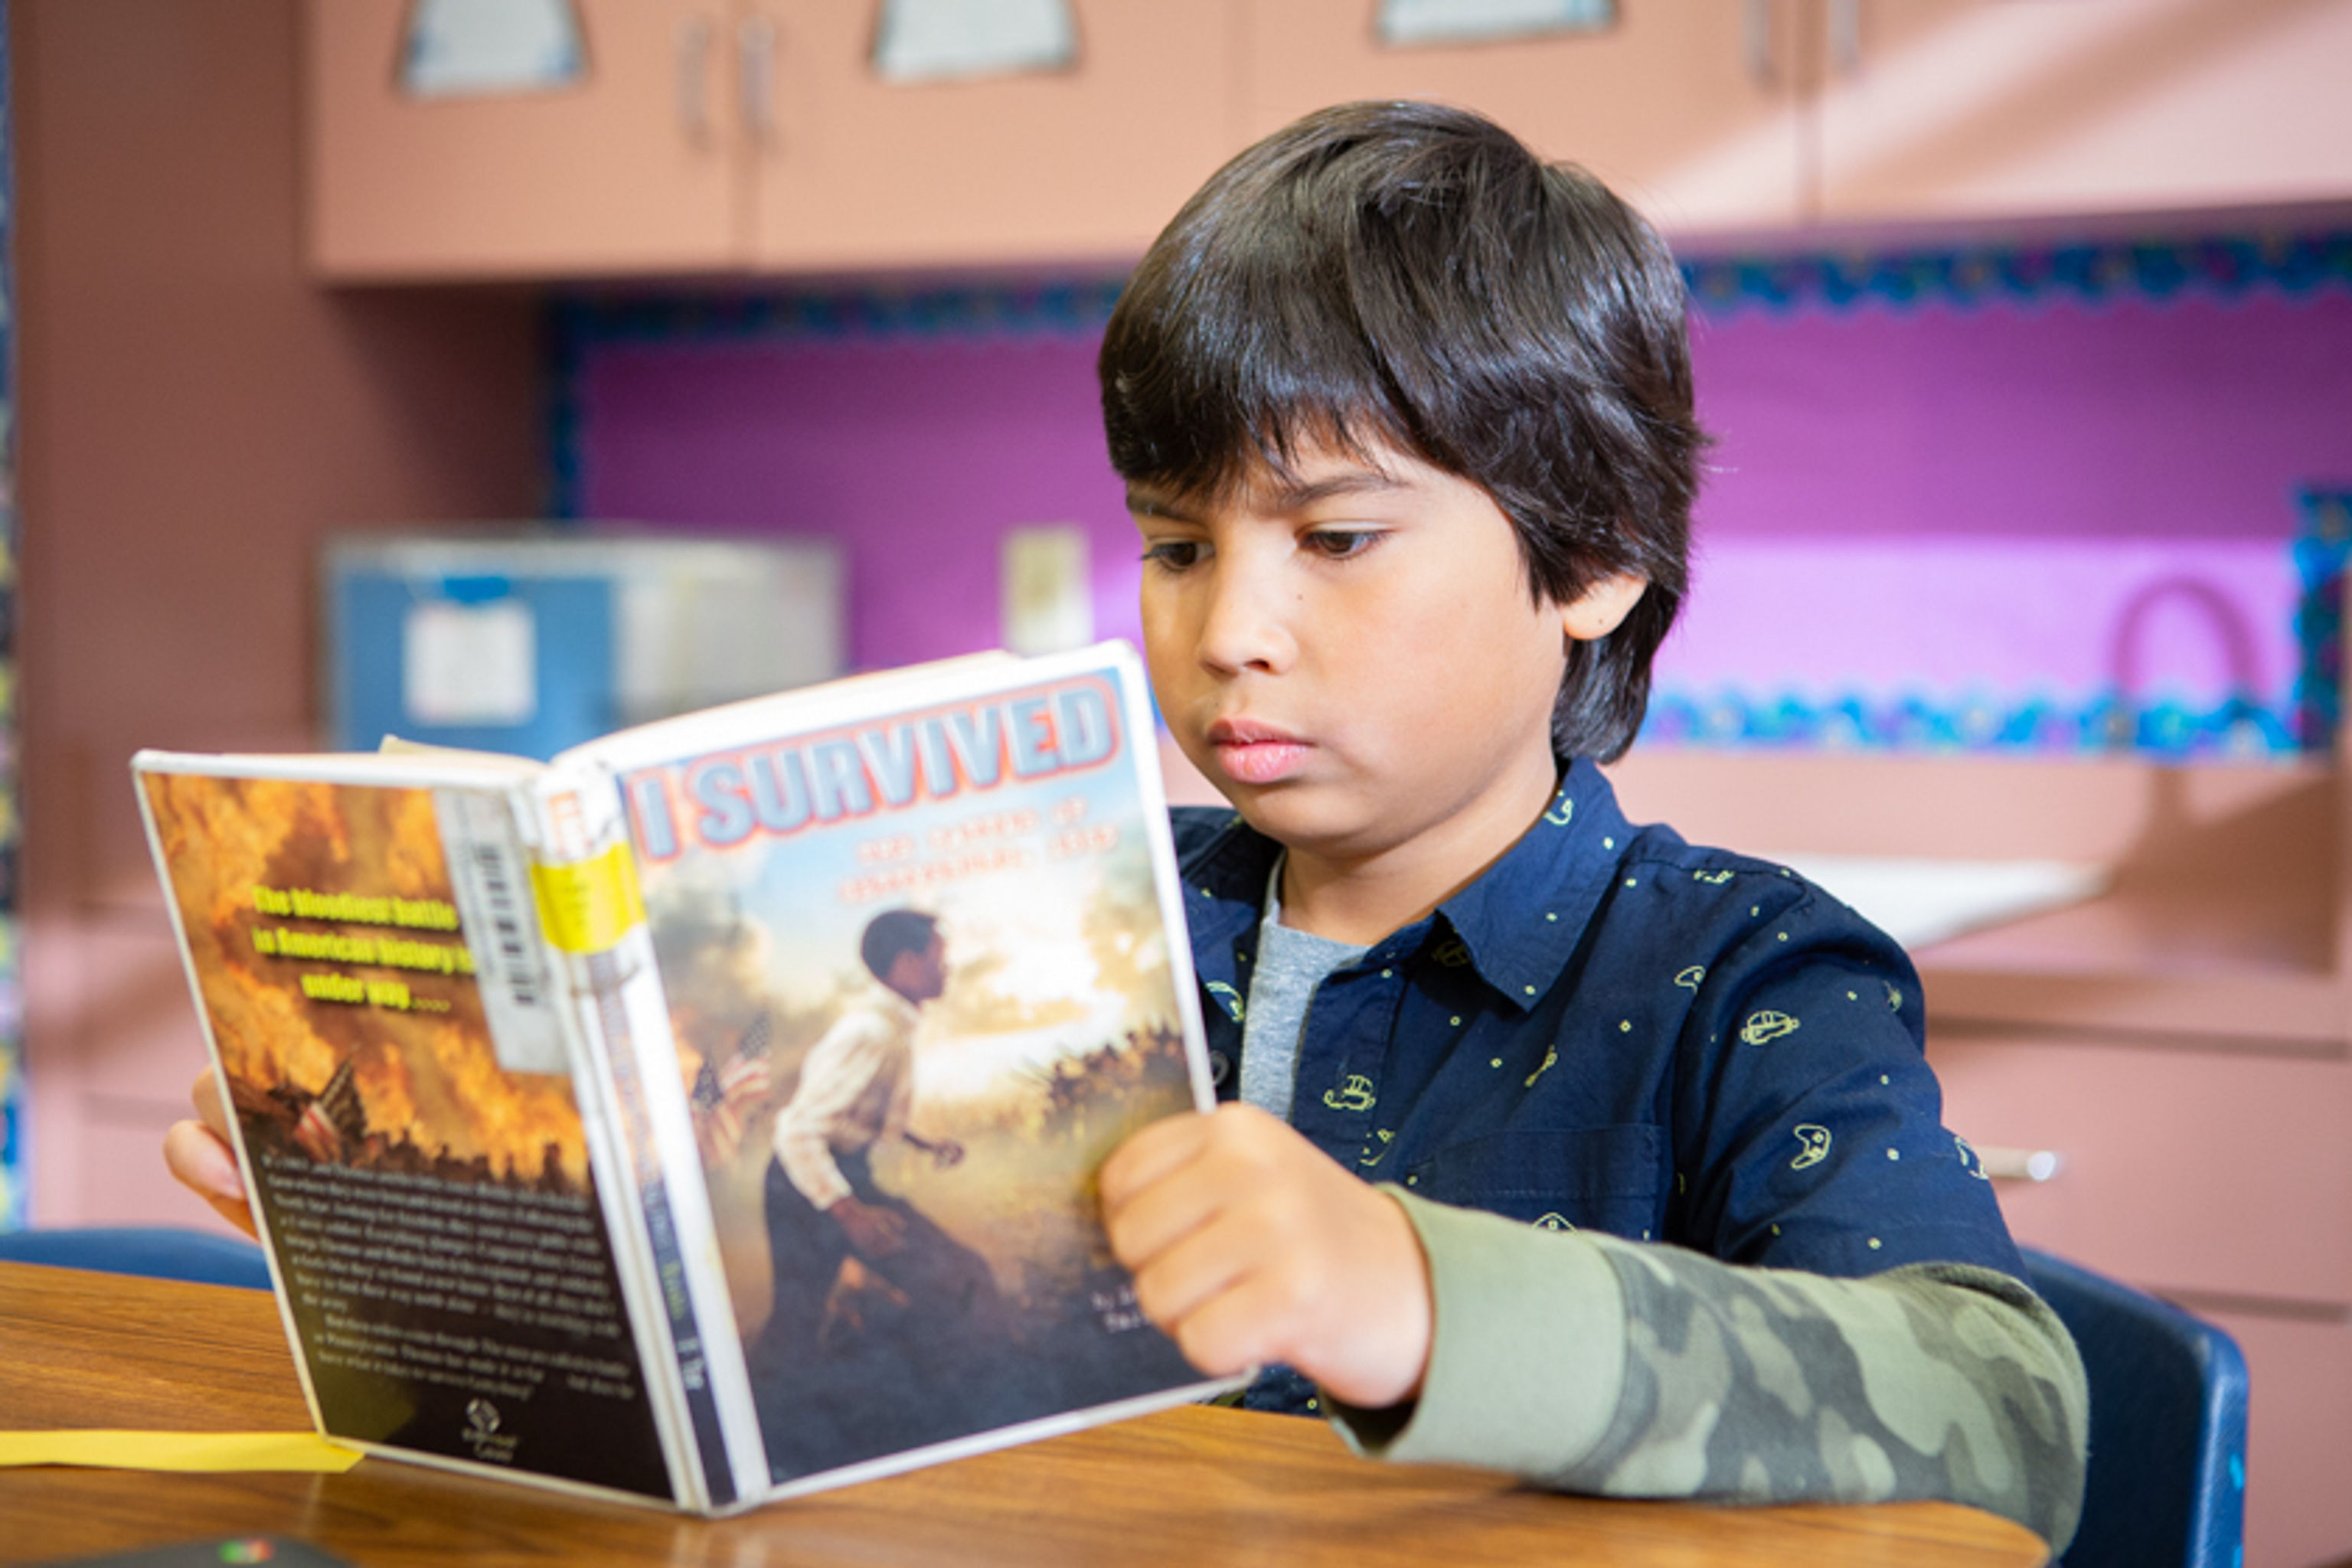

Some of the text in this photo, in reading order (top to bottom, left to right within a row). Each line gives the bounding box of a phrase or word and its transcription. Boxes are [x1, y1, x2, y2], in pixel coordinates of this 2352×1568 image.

[632, 773, 679, 861] I
[691, 681, 1116, 848] SURVIVED
[290, 888, 392, 924] bloodiest
[391, 896, 458, 930] battle
[276, 927, 377, 964] American
[377, 936, 453, 975] history
[302, 972, 364, 1004] under
